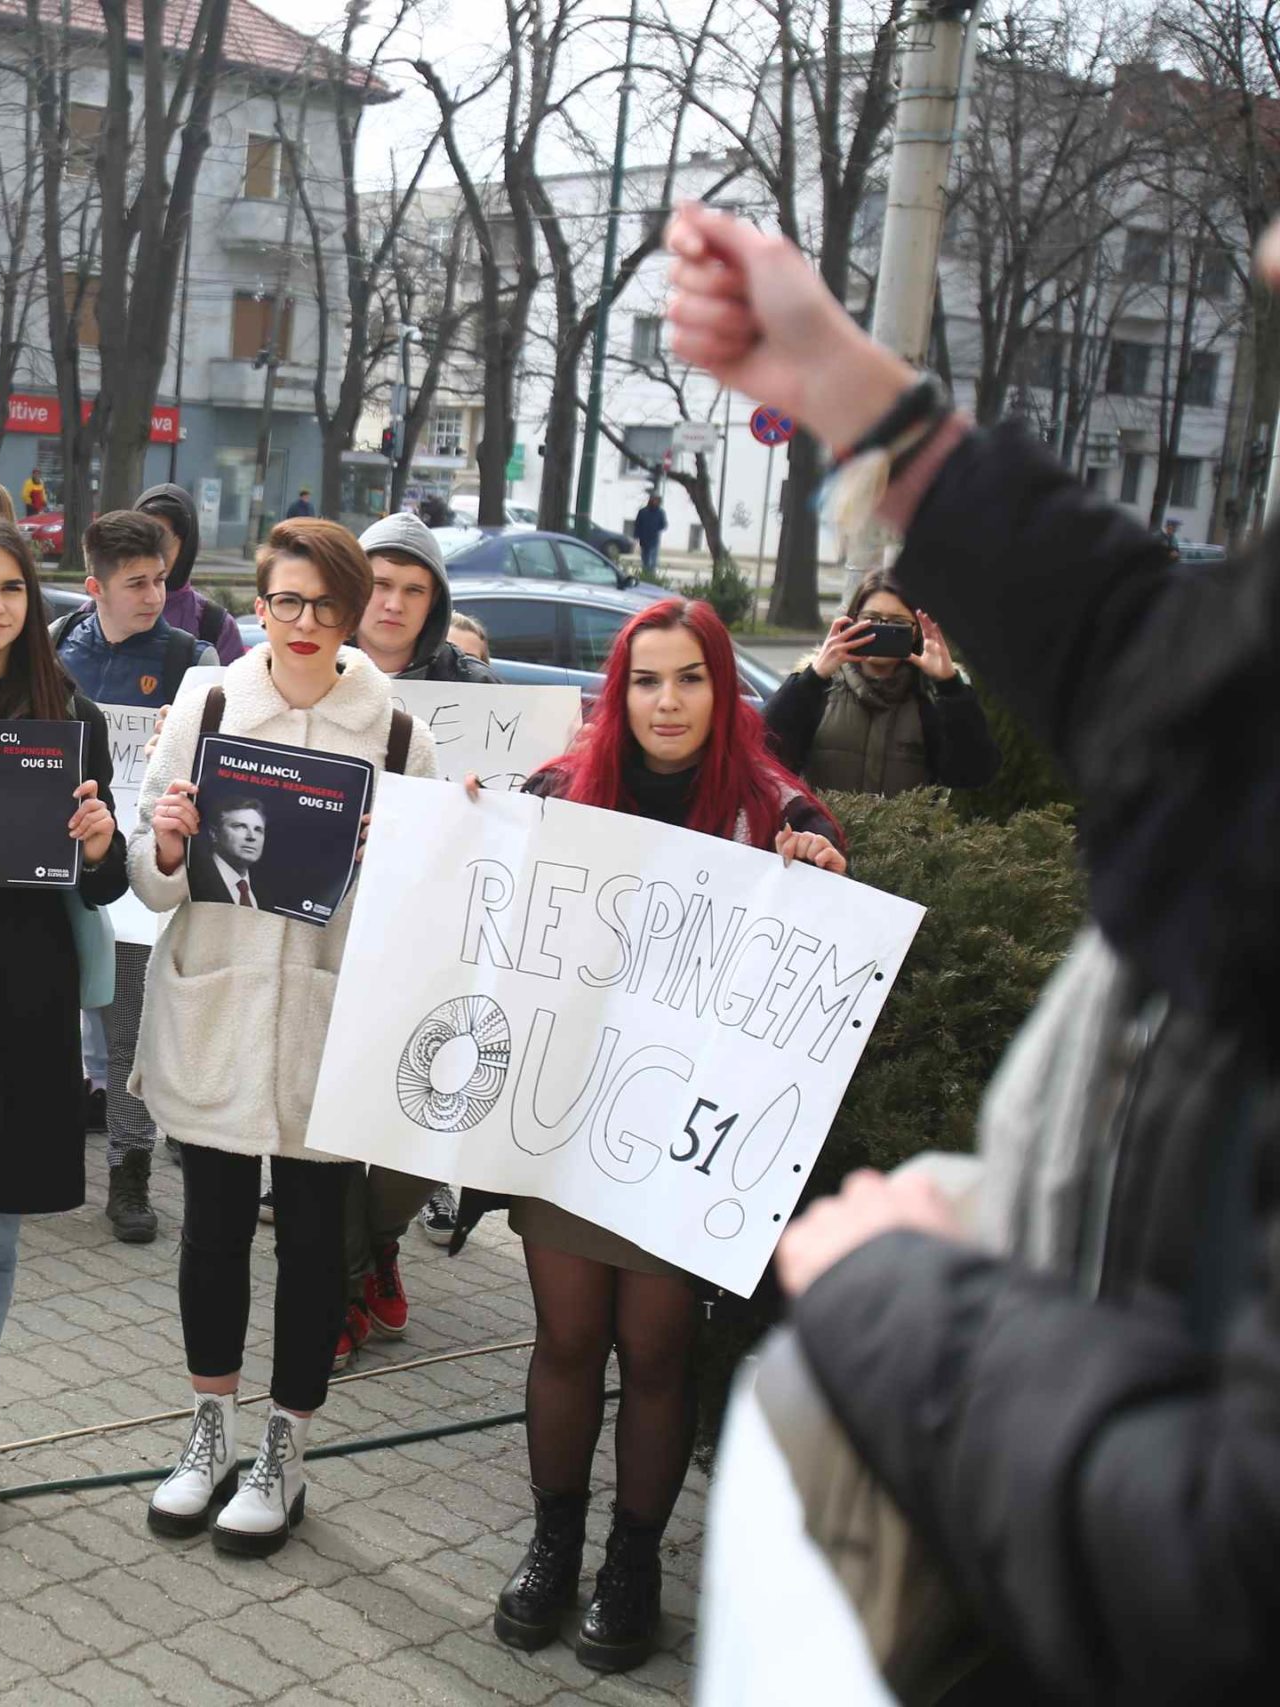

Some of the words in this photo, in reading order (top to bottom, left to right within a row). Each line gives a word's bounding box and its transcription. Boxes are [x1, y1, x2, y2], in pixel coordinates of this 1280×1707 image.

[21, 758, 45, 768] OUG
[46, 759, 63, 769] 51!
[220, 755, 259, 772] IULIAN
[260, 764, 302, 782] IANCU,
[298, 796, 324, 809] OUG
[324, 801, 344, 813] 51!
[397, 994, 695, 1184] OUG
